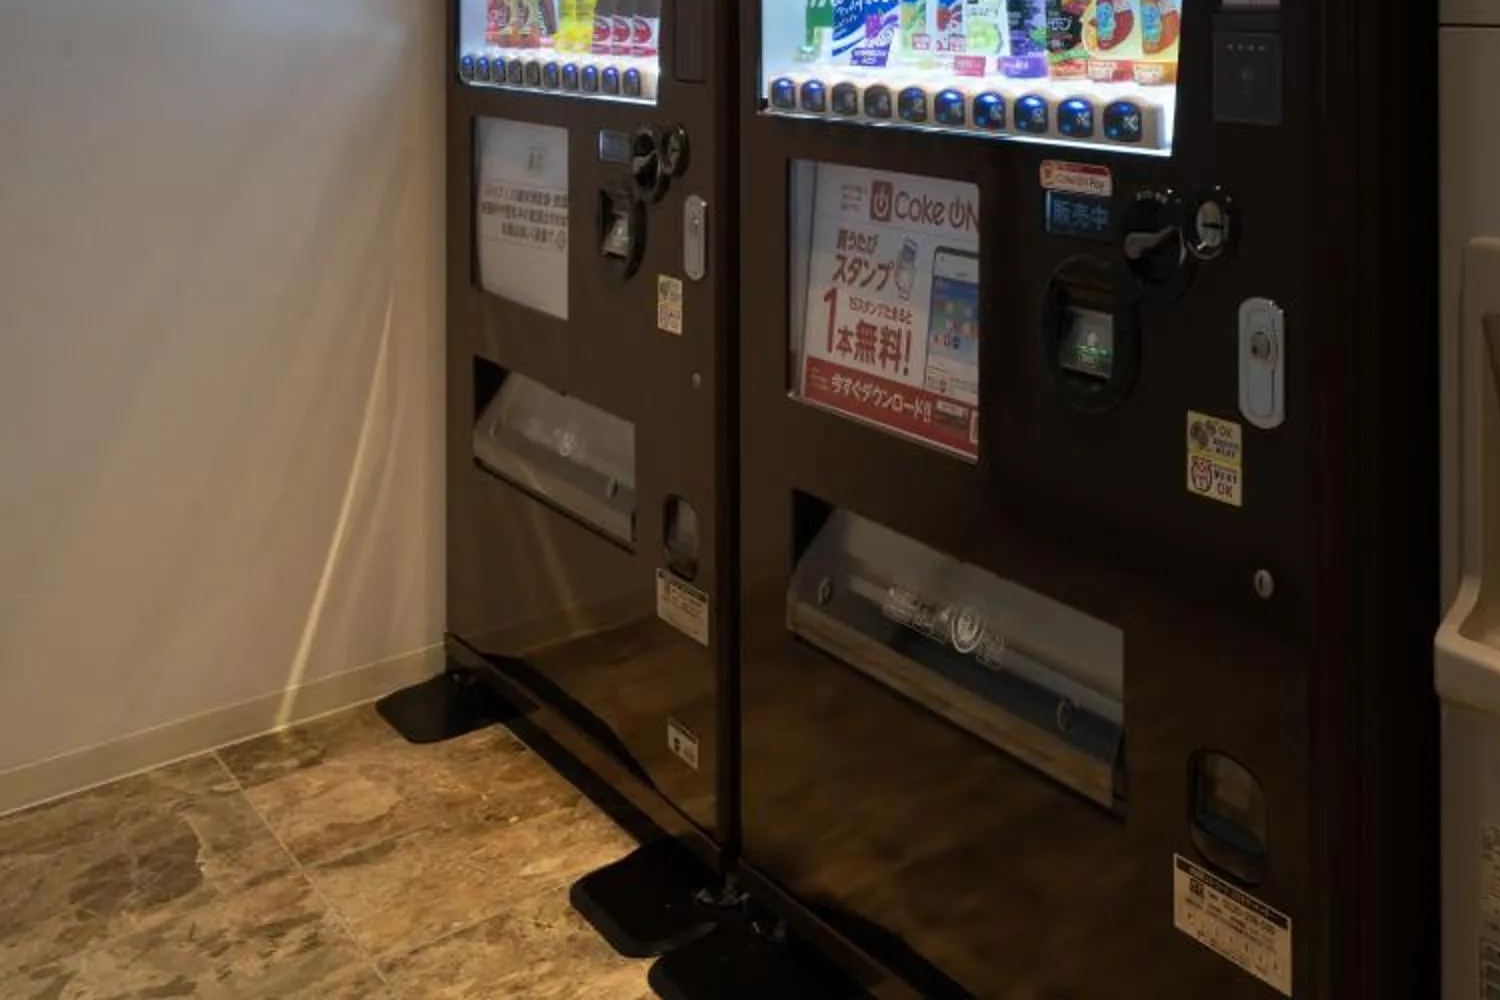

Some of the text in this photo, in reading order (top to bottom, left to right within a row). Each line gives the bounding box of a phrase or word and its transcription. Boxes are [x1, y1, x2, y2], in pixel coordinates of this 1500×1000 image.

[894, 190, 945, 226] Coke
[1053, 199, 1109, 231] 販売中
[832, 253, 894, 290] スタンプ
